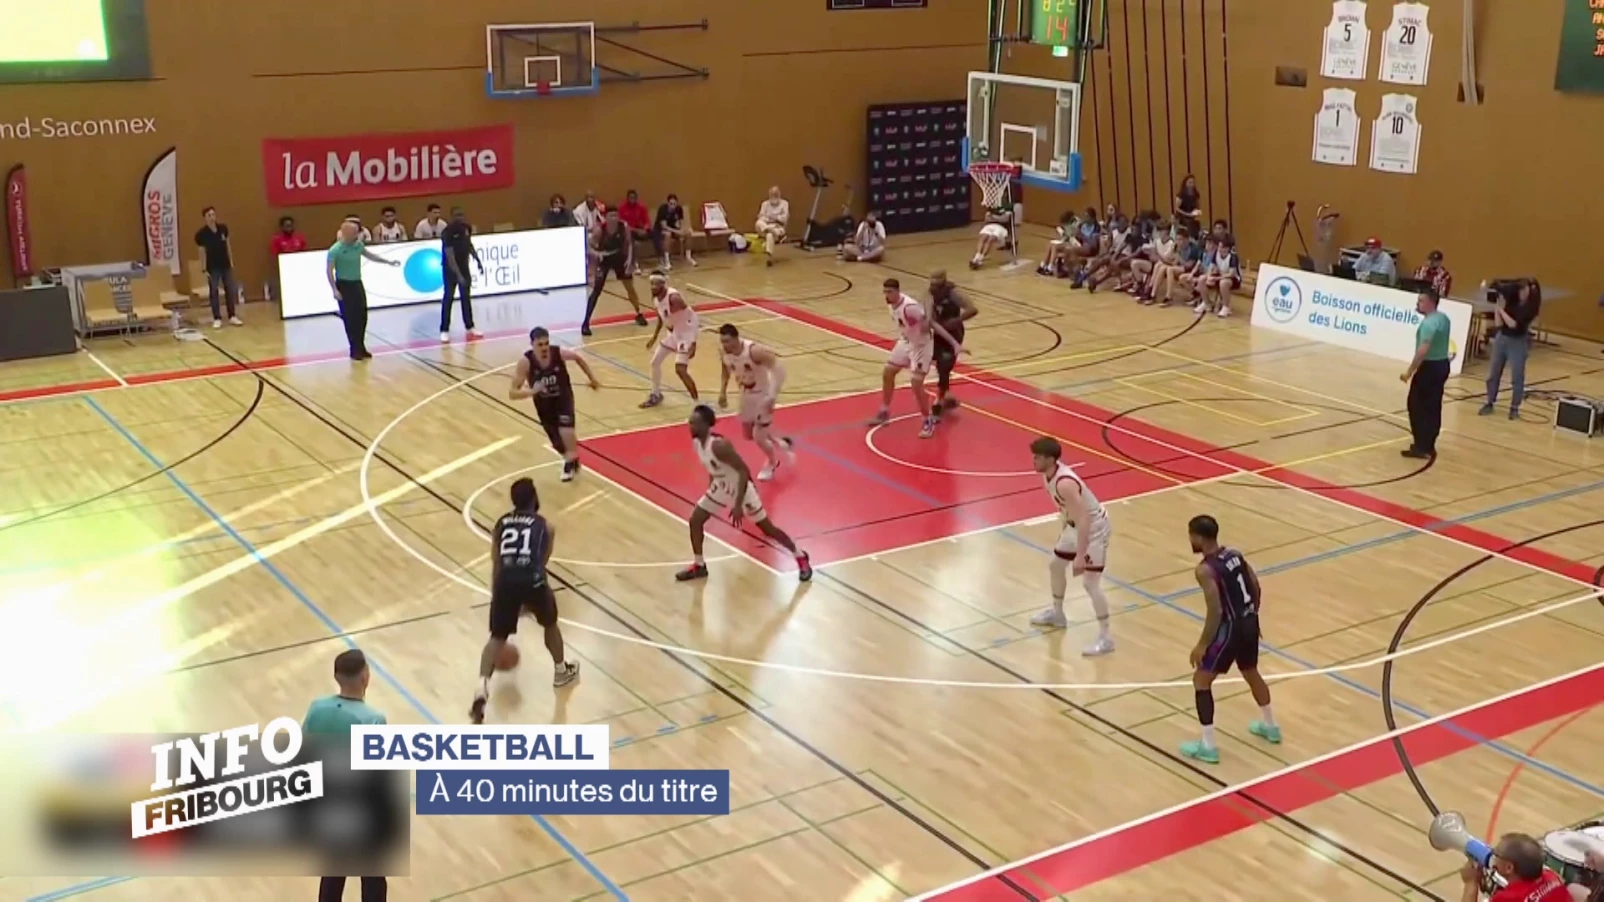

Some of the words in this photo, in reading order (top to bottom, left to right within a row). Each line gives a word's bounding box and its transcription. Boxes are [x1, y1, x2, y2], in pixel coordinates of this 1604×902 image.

[1046, 14, 1068, 41] 14
[1343, 23, 1352, 42] 5
[1399, 25, 1416, 46] 20
[1335, 109, 1341, 127] 1
[1392, 115, 1405, 135] 10
[282, 152, 318, 190] la
[325, 145, 498, 187] Mobilière
[148, 190, 162, 260] MIGROS
[476, 242, 520, 266] nique
[1272, 297, 1293, 310] eau
[1312, 289, 1360, 313] Boisson
[1363, 303, 1420, 325] officielle
[1308, 311, 1331, 327] des
[1333, 314, 1368, 335] Lions
[500, 527, 532, 556] 21
[1236, 573, 1251, 604] 1
